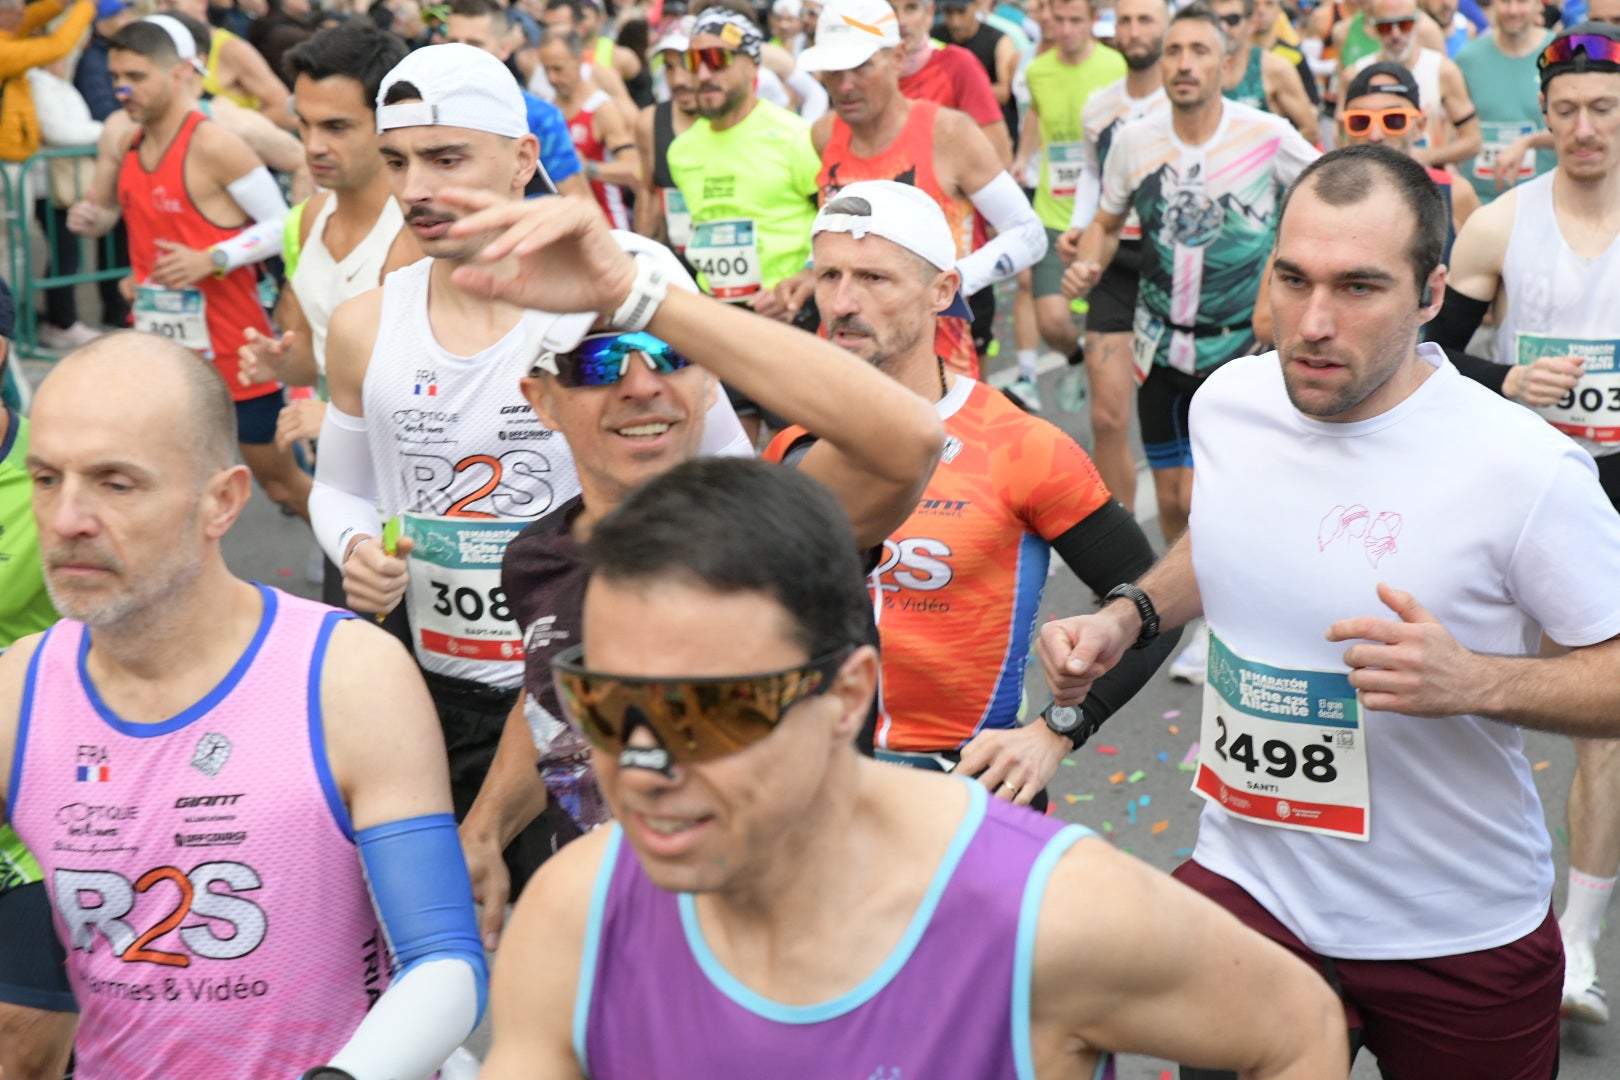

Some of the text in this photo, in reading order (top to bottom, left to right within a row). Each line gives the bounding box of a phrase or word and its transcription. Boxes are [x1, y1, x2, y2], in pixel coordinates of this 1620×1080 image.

[415, 369, 437, 383] FRA
[500, 404, 531, 414] GIA
[400, 449, 554, 518] R2S
[866, 537, 953, 592] 2S
[430, 580, 516, 621] 308
[901, 597, 950, 613] Vidéo
[1251, 673, 1308, 690] MARATÓN
[1239, 683, 1308, 707] Elche 42K
[1240, 695, 1310, 717] Alicante
[77, 745, 109, 763] FRA
[1215, 716, 1337, 783] 2498
[1246, 781, 1279, 792] SANTI
[174, 793, 246, 808] GIANT
[55, 861, 267, 967] R2S
[165, 977, 181, 1001] &
[187, 974, 268, 1001] Vidéo
